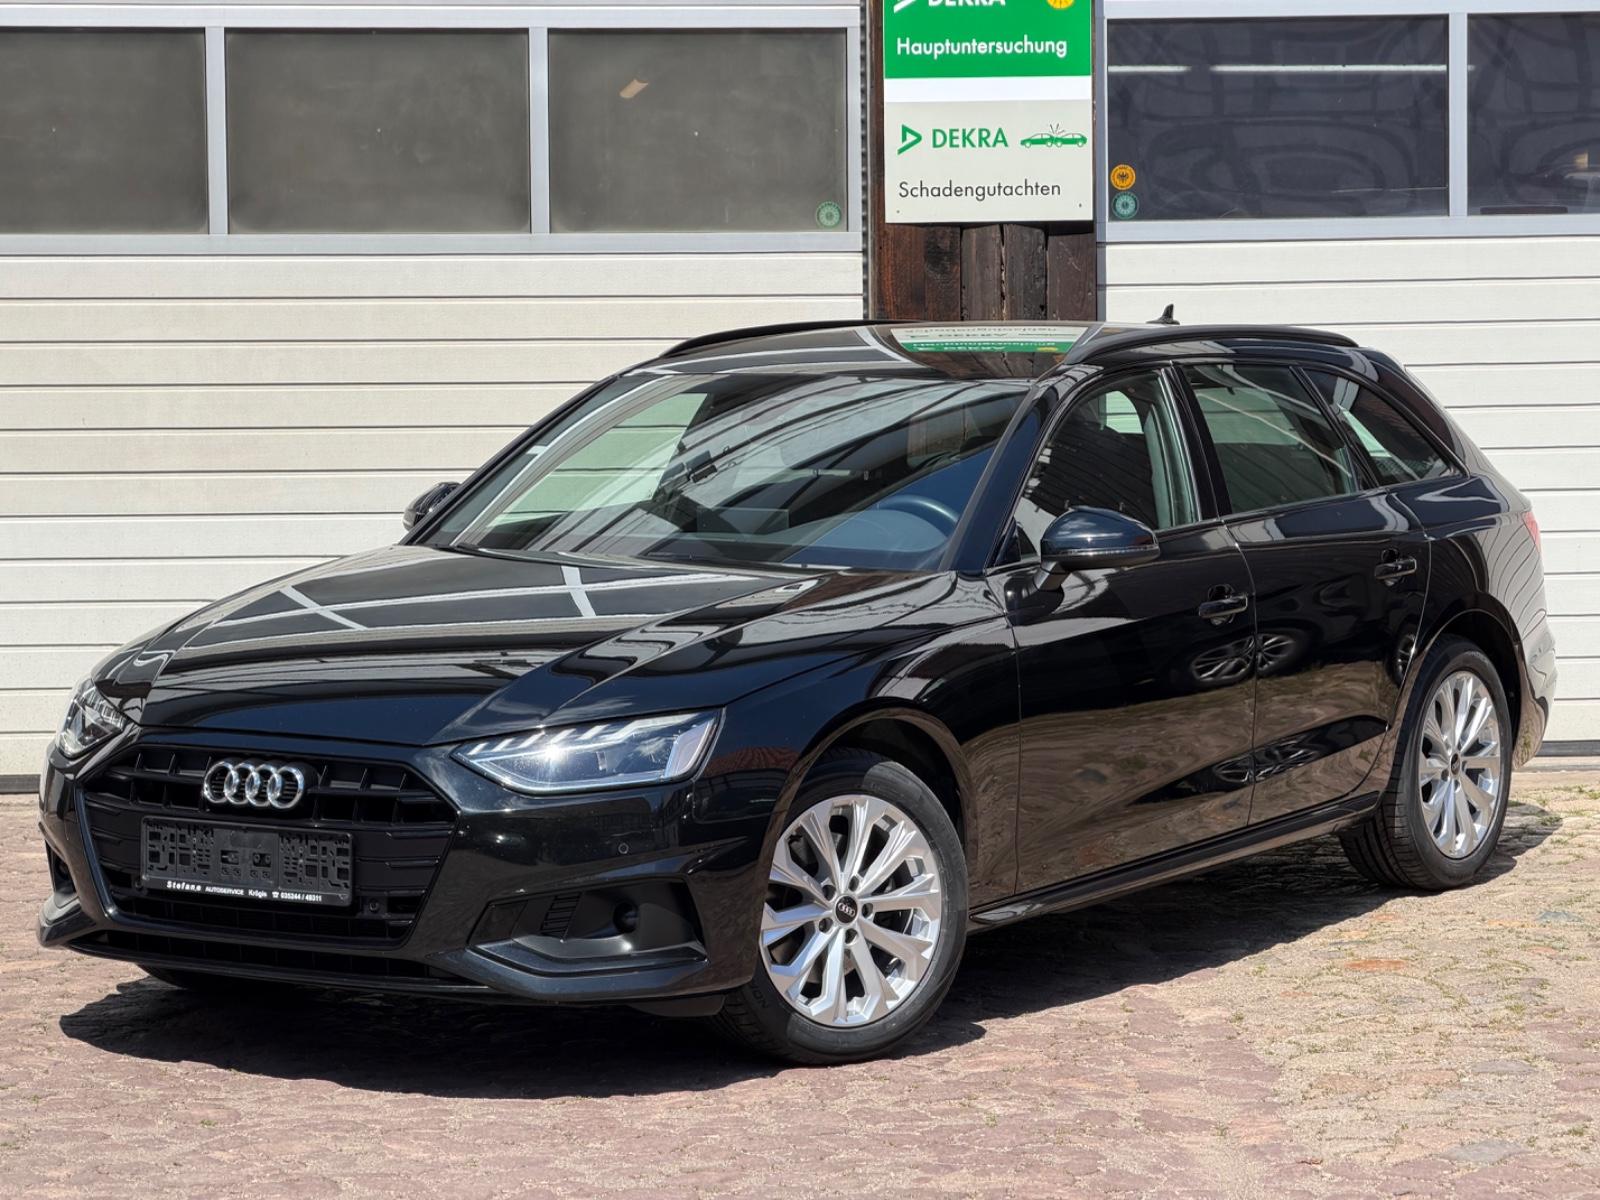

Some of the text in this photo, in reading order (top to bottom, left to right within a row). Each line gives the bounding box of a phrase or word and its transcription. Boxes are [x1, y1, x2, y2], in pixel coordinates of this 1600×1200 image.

[896, 34, 1068, 60] Hauptuntersuchung
[931, 127, 1009, 149] DEKRA
[898, 178, 1062, 202] Schadengutachten
